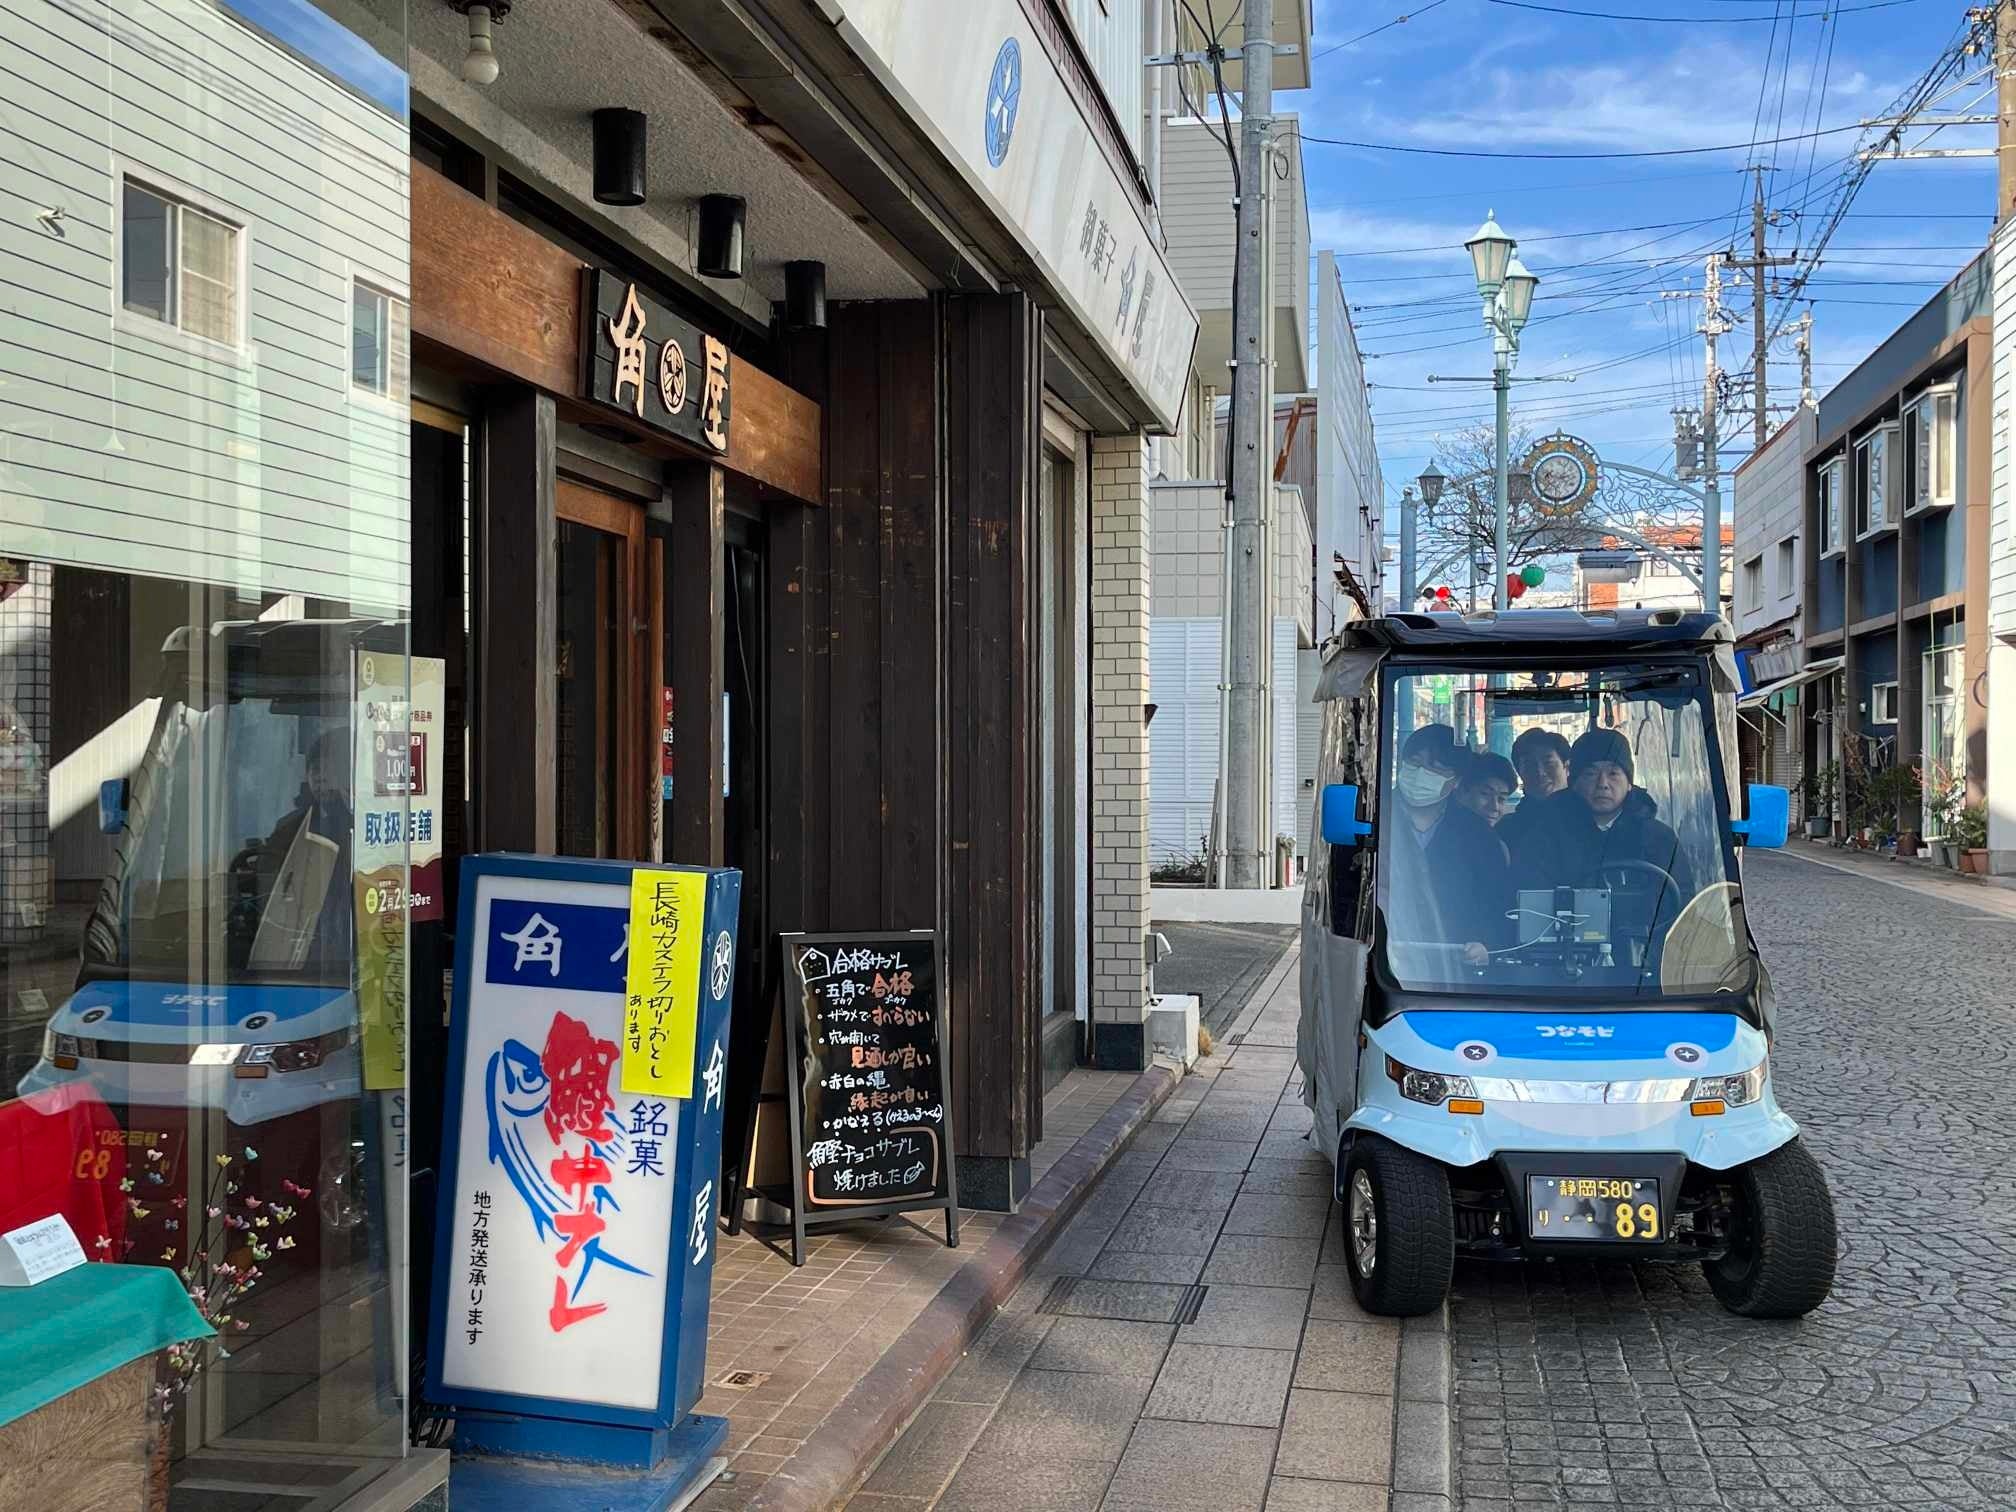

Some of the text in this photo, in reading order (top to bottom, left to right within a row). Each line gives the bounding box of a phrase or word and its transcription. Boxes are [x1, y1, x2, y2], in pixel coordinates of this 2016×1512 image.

[1079, 200, 1117, 285] 御菓子
[1115, 243, 1156, 360] 角屋
[646, 880, 682, 1080] 長崎カステラ切りおとし
[831, 947, 909, 975] 合格サブレ
[627, 993, 643, 1054] あります
[626, 1099, 669, 1178] 銘菓
[1538, 1202, 1658, 1239] り 89
[1559, 1179, 1633, 1199] 静岡580
[466, 1189, 492, 1346] 地方発送承ります
